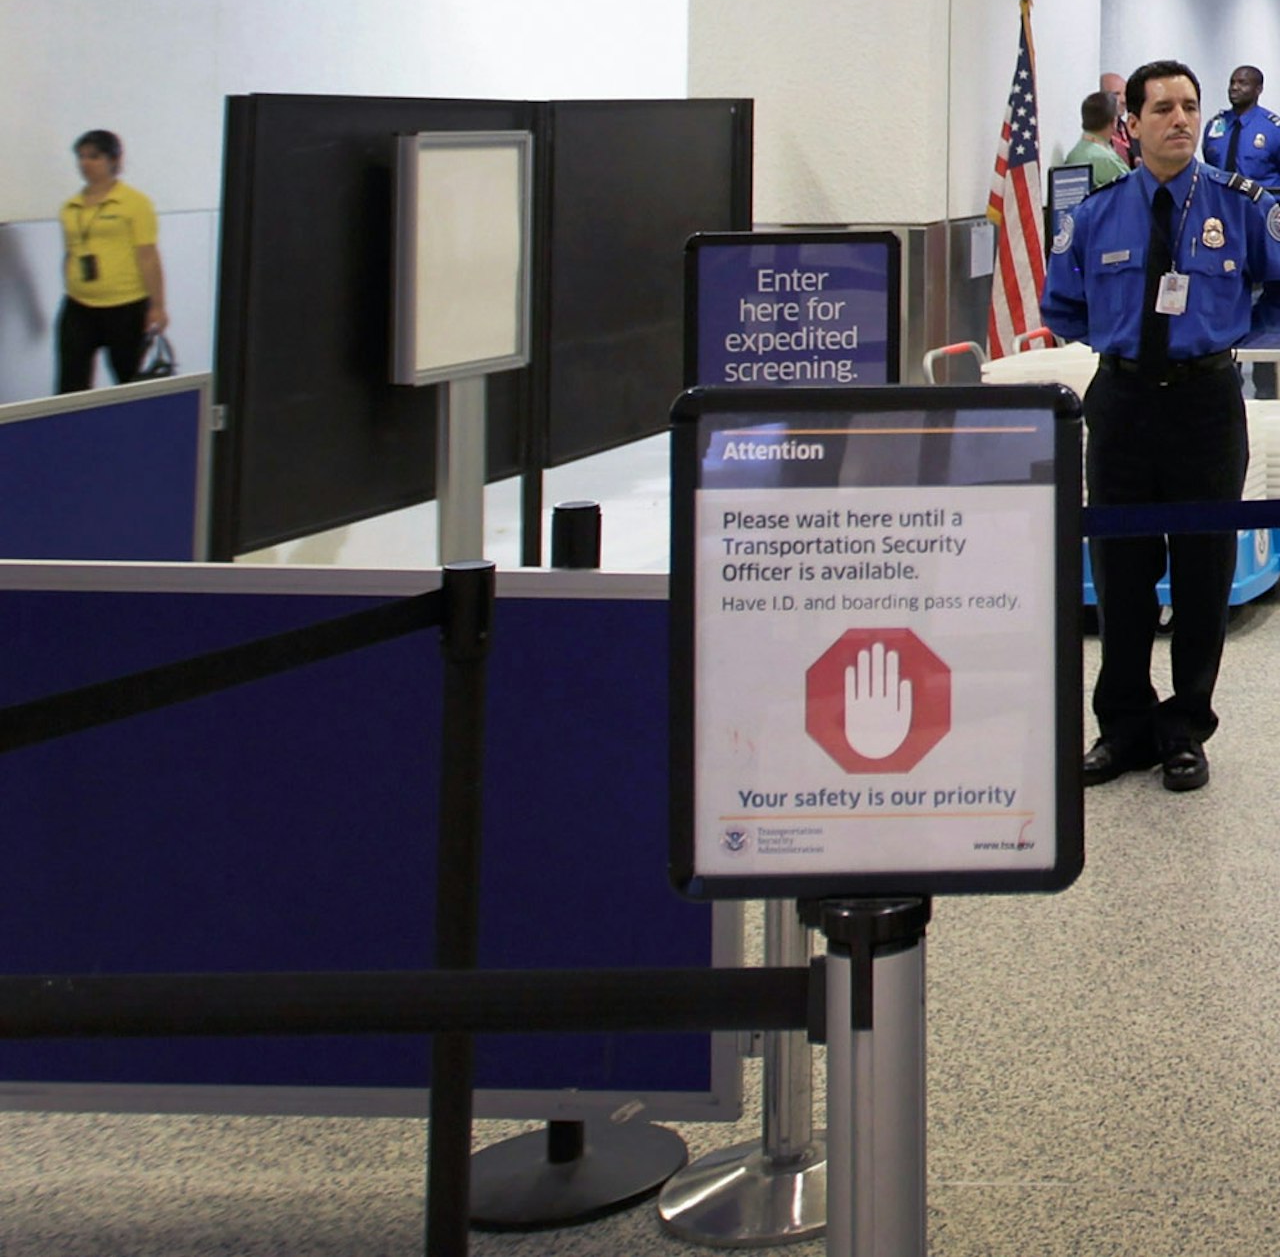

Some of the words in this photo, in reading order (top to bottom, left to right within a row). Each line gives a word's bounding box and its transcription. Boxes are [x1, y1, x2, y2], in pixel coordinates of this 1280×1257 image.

[758, 269, 829, 292] Enter
[740, 298, 799, 322] here
[807, 297, 846, 321] for
[725, 325, 858, 355] expedited
[724, 355, 858, 383] screening.
[723, 441, 825, 461] Attention
[722, 511, 789, 529] Please
[796, 511, 840, 528] wait
[847, 510, 893, 528] here
[899, 509, 945, 527] until
[951, 513, 963, 527] a
[722, 537, 875, 557] Transportation
[882, 536, 966, 556] Security
[722, 563, 793, 582] Officer
[799, 563, 815, 580] is
[821, 562, 919, 580] available.
[721, 596, 767, 611] Have
[772, 596, 798, 611] I.D.
[804, 595, 836, 610] and
[842, 594, 919, 612] boarding
[924, 597, 963, 611] pass
[968, 593, 1021, 610] ready.
[738, 790, 787, 808] Your
[795, 789, 861, 810] safety
[868, 788, 885, 806] is
[891, 791, 926, 807] our
[934, 787, 1017, 808] priority
